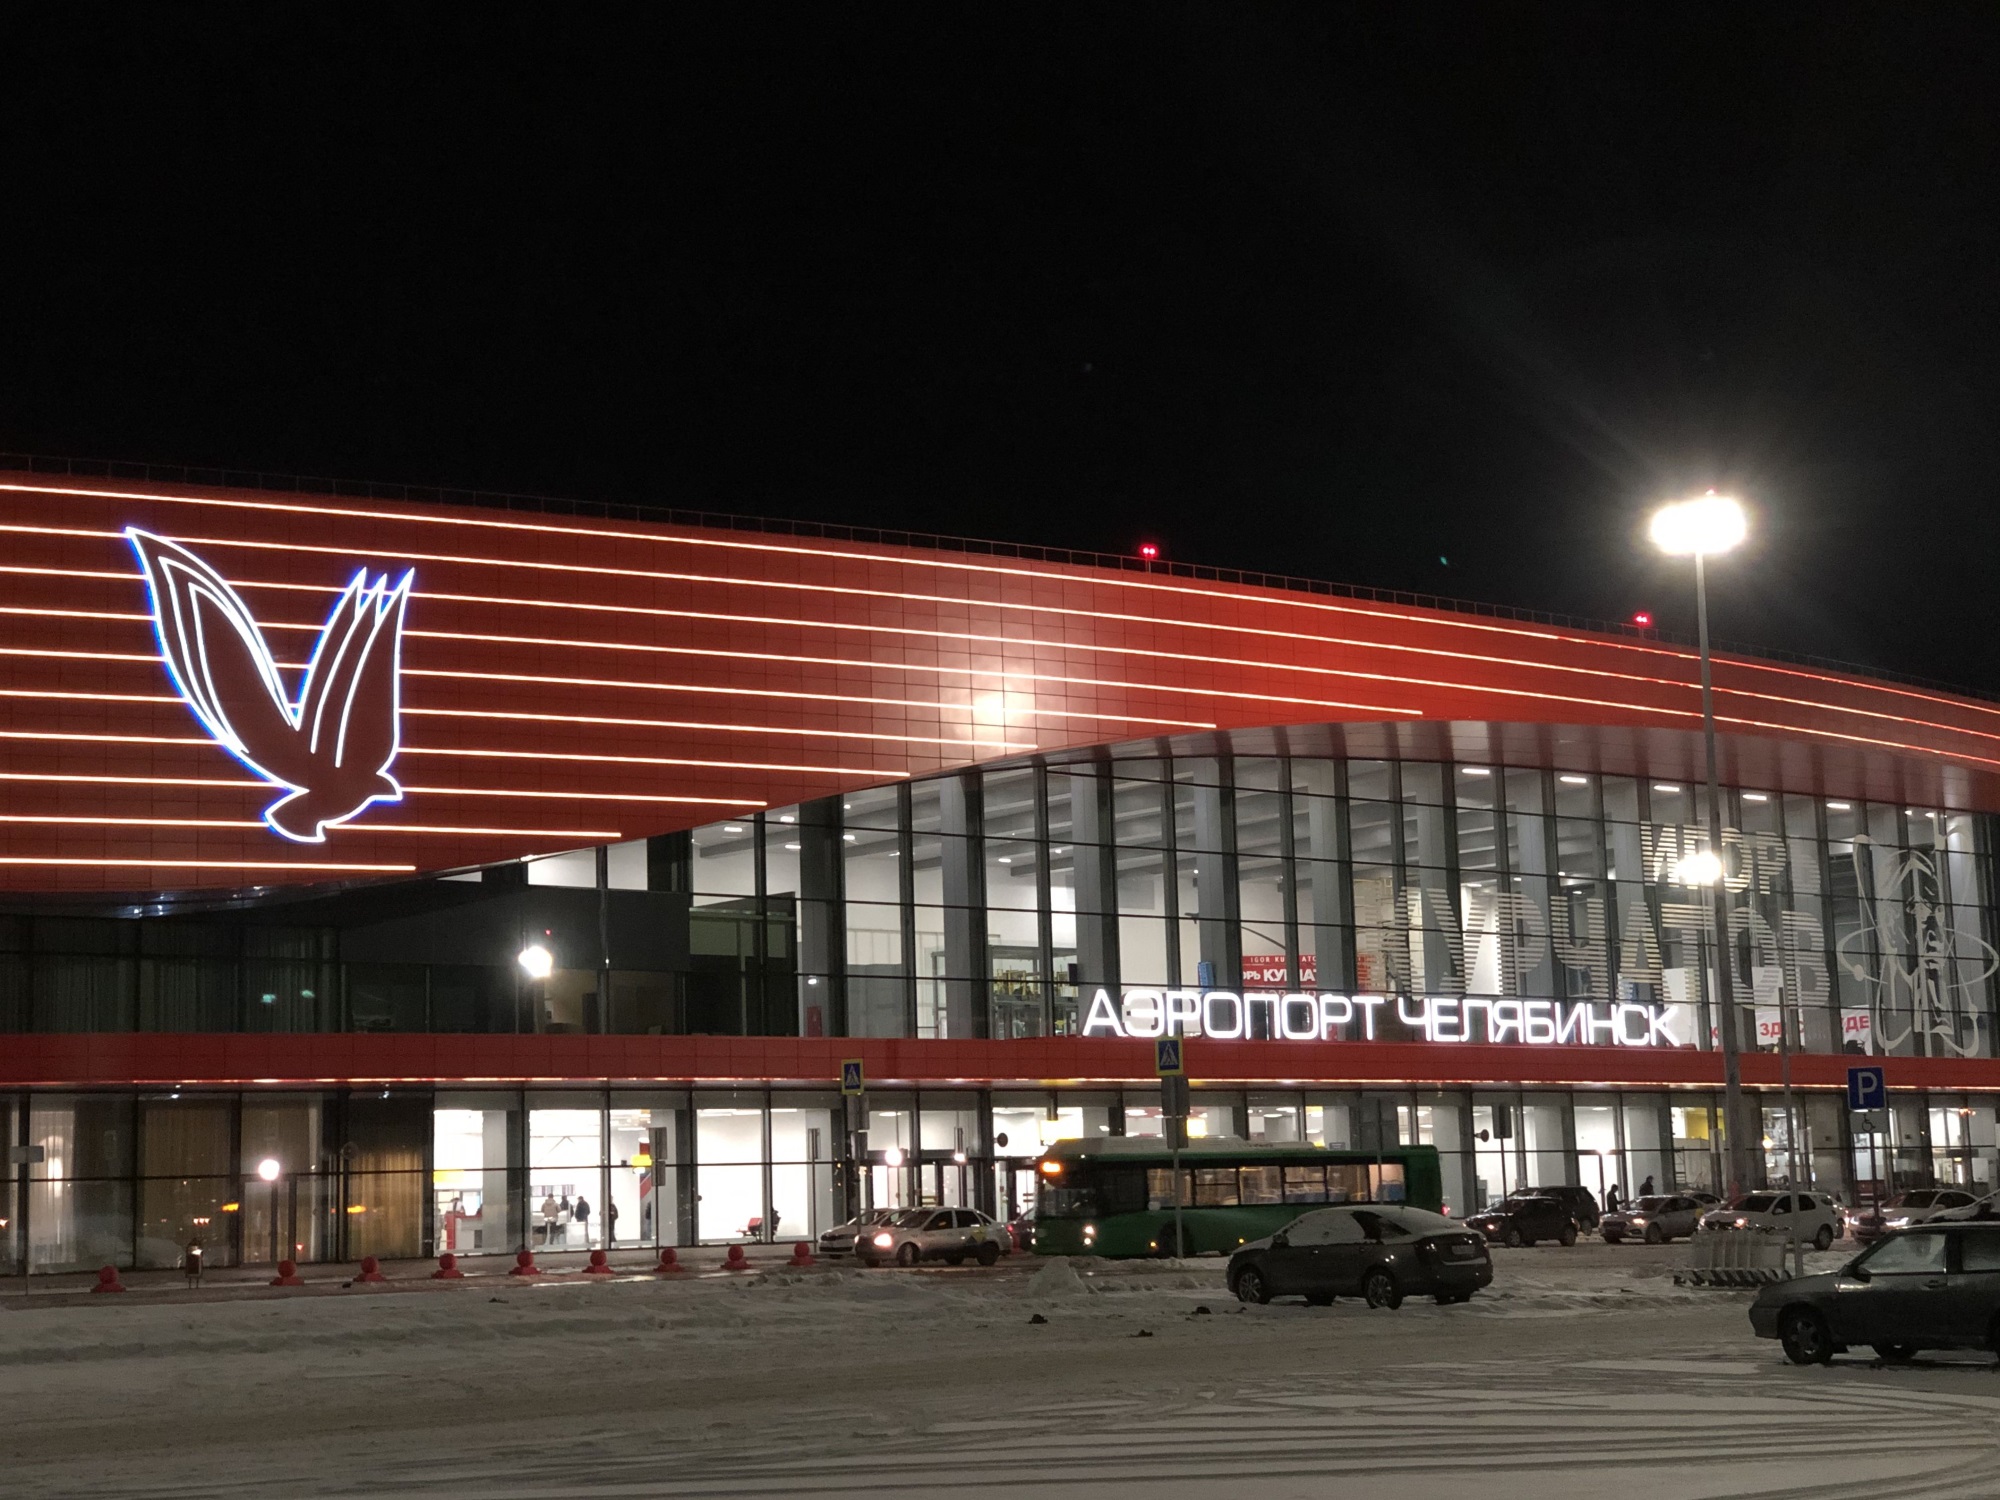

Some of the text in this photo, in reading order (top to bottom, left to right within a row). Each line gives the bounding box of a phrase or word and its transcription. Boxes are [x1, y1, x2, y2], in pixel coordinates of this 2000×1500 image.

[1082, 988, 1680, 1047] АЭРОПОРТ ЧЕЛЯБИНСК
[1857, 1071, 1878, 1105] P
